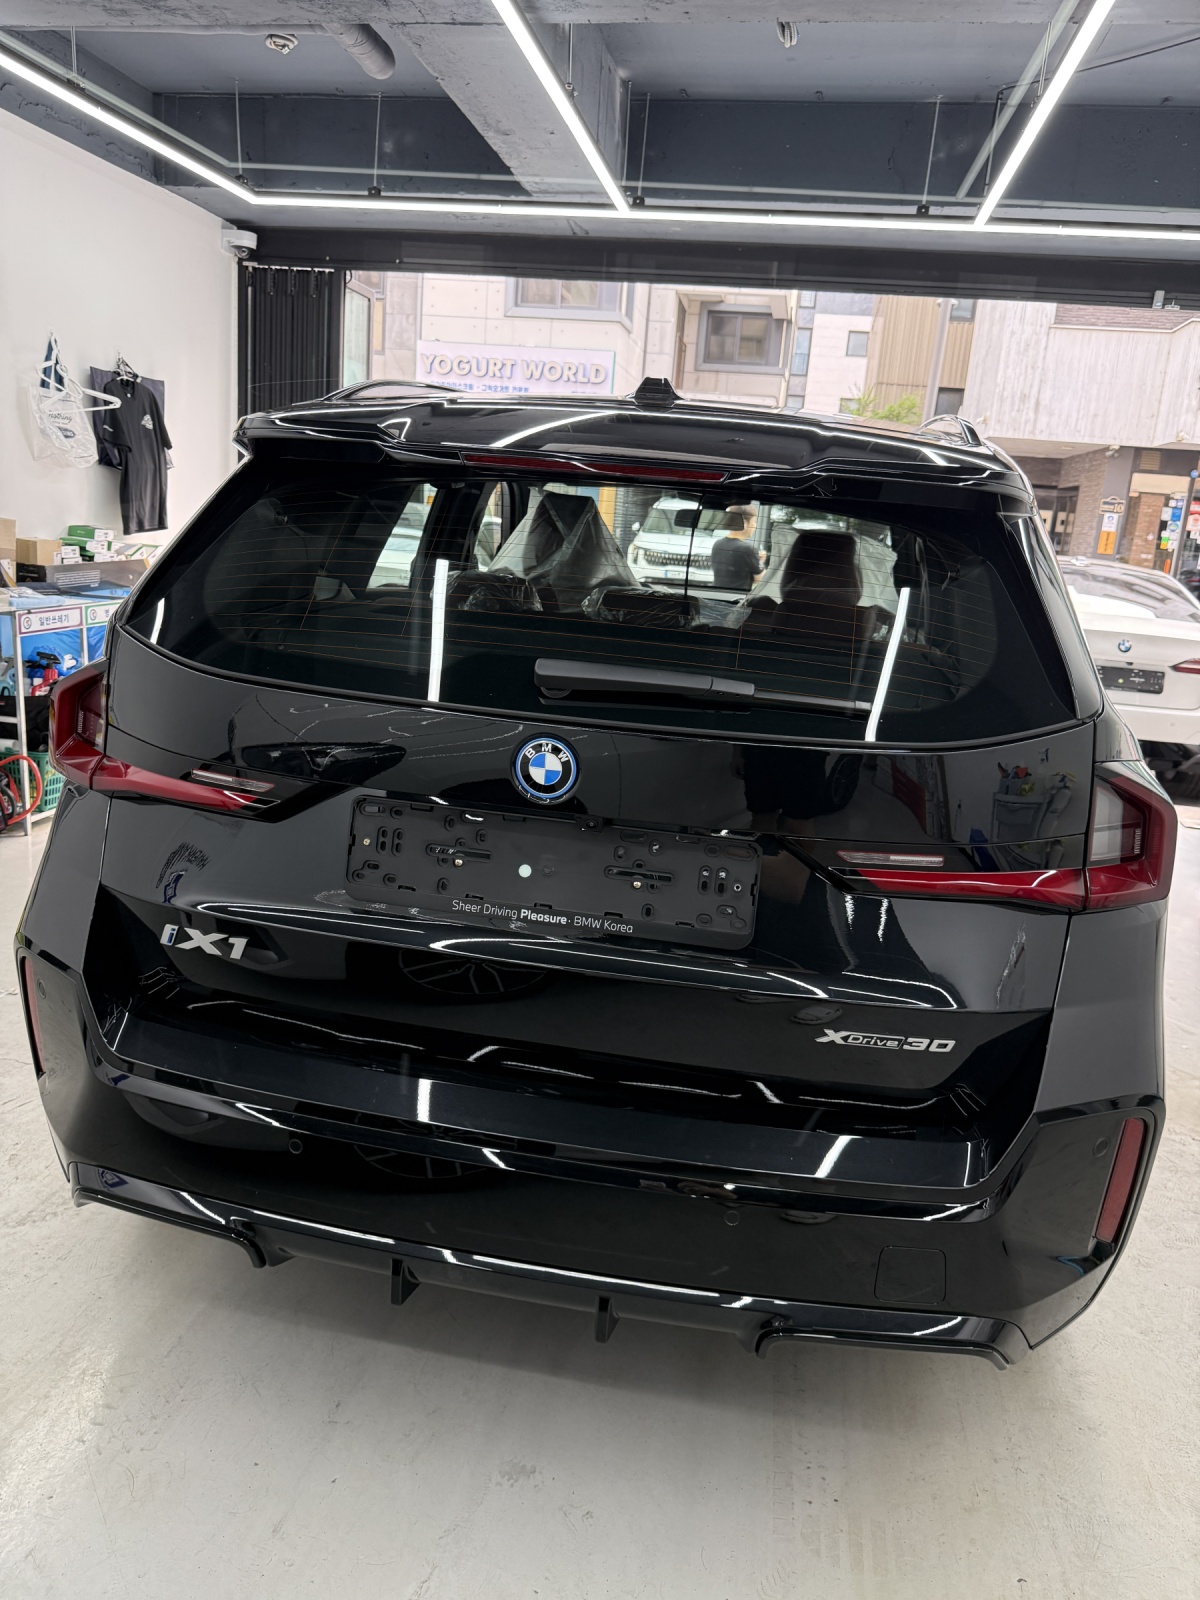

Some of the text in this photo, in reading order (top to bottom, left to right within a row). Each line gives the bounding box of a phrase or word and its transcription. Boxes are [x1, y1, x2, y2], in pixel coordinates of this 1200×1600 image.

[420, 354, 607, 385] YOGURT WORLD
[38, 613, 70, 626] 일반쓰레기
[525, 742, 570, 762] BMW
[452, 899, 481, 913] Sheer
[483, 904, 518, 919] Driving
[573, 915, 602, 929] BMW
[603, 920, 633, 933] Korea
